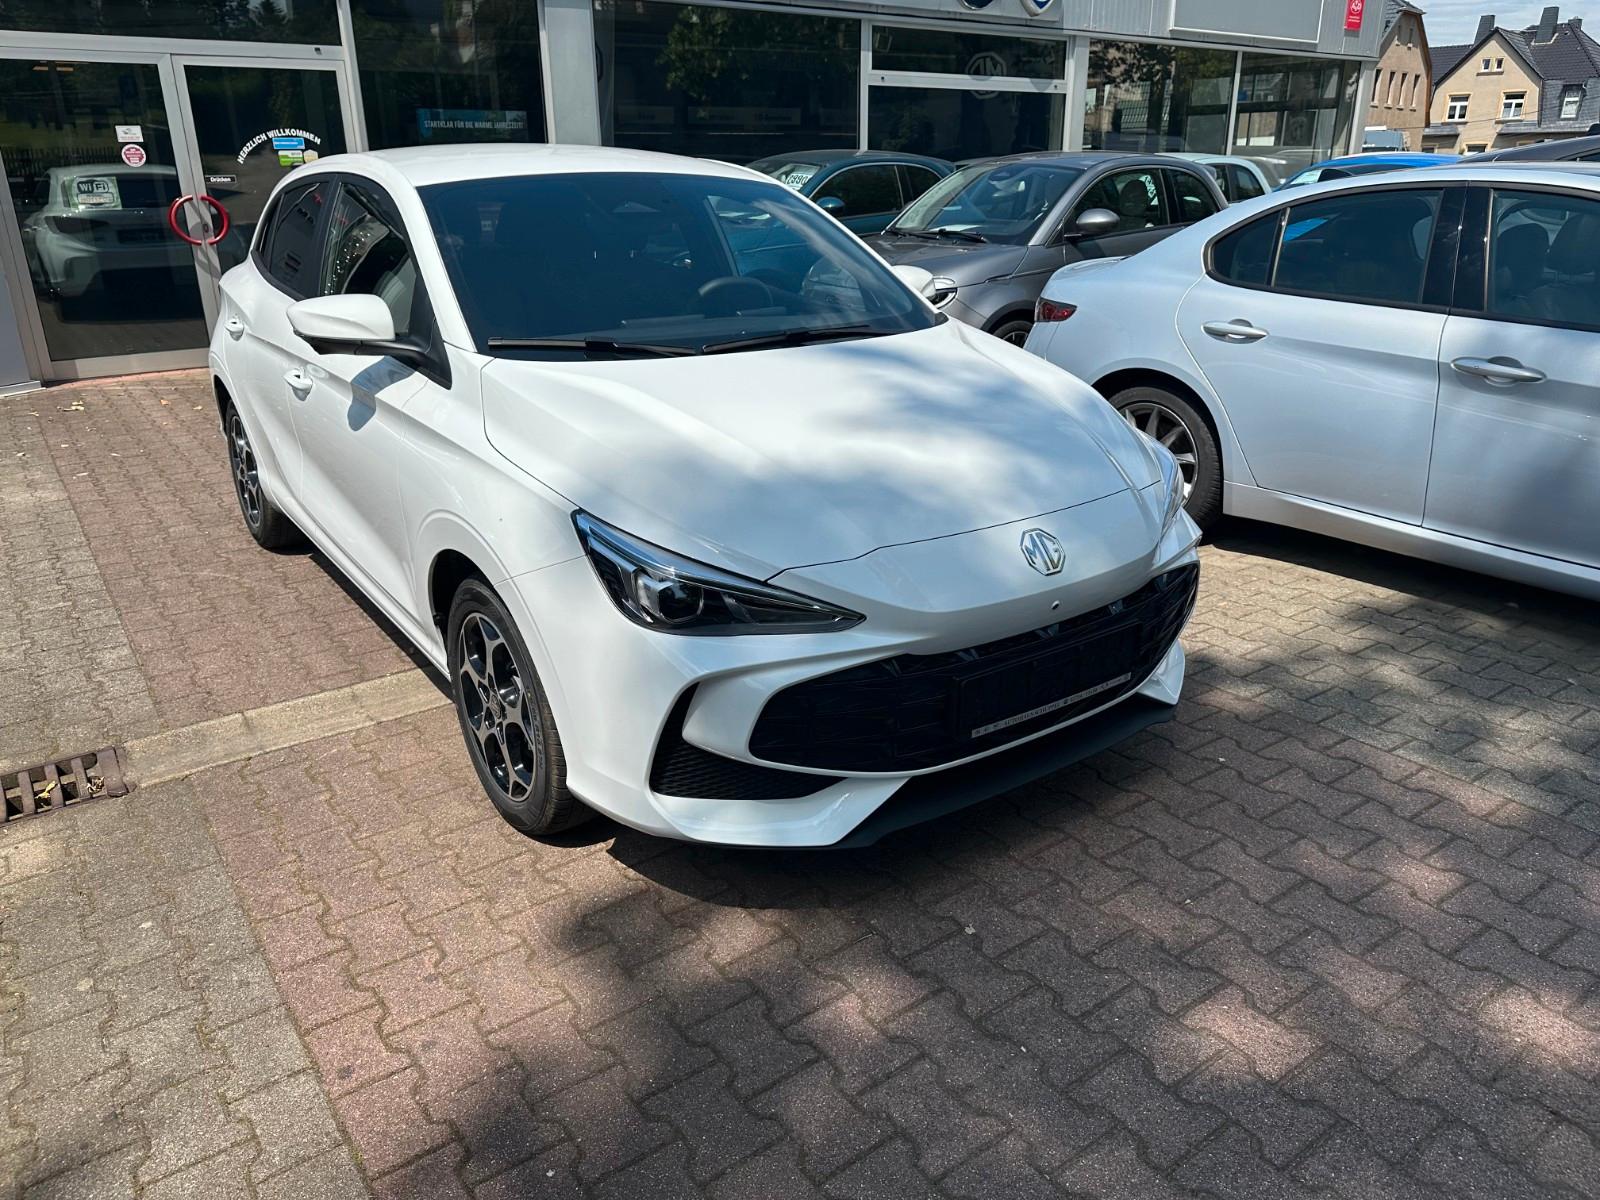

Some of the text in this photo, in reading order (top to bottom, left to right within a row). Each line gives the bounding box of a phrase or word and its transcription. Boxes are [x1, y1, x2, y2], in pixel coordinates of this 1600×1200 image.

[236, 132, 268, 165] HERZLICH
[267, 128, 321, 145] WILLKOMMEN
[1024, 531, 1062, 572] MG
